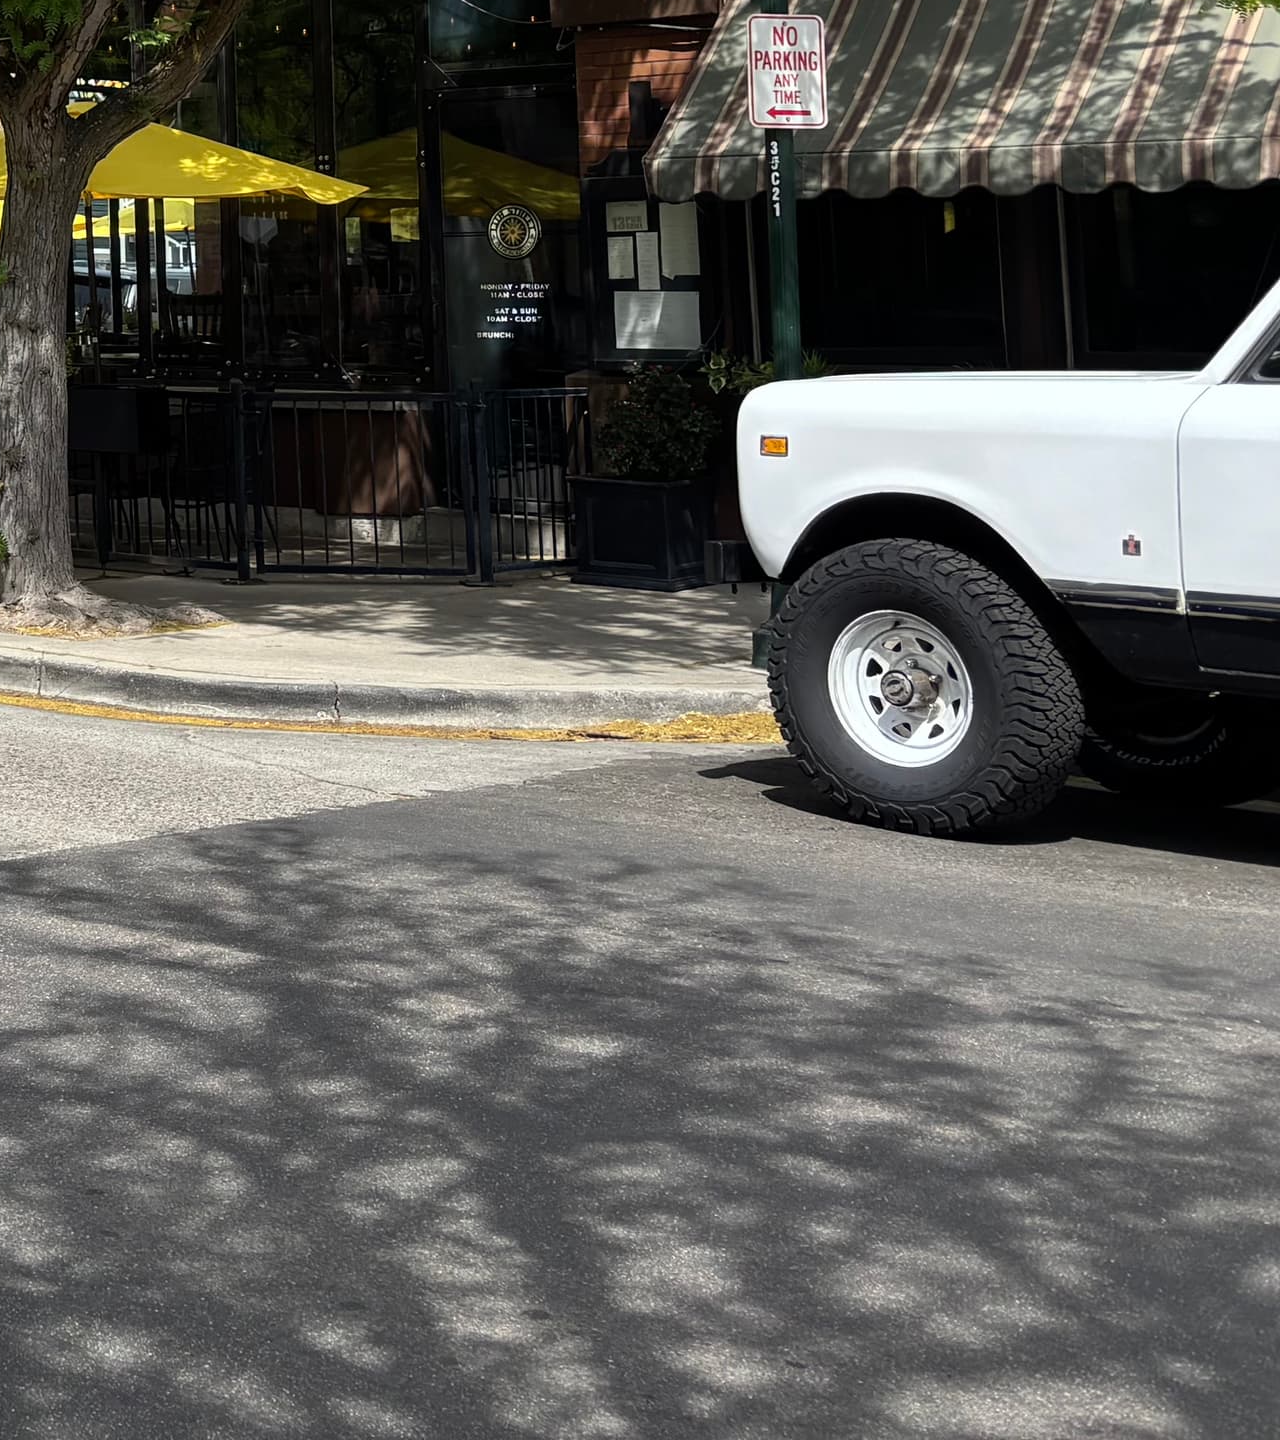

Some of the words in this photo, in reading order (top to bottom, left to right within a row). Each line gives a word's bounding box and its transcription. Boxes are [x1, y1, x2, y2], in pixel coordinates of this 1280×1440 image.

[772, 26, 798, 46] NO
[754, 50, 818, 72] PARKING
[773, 74, 799, 88] ANY
[773, 90, 802, 105] TIME
